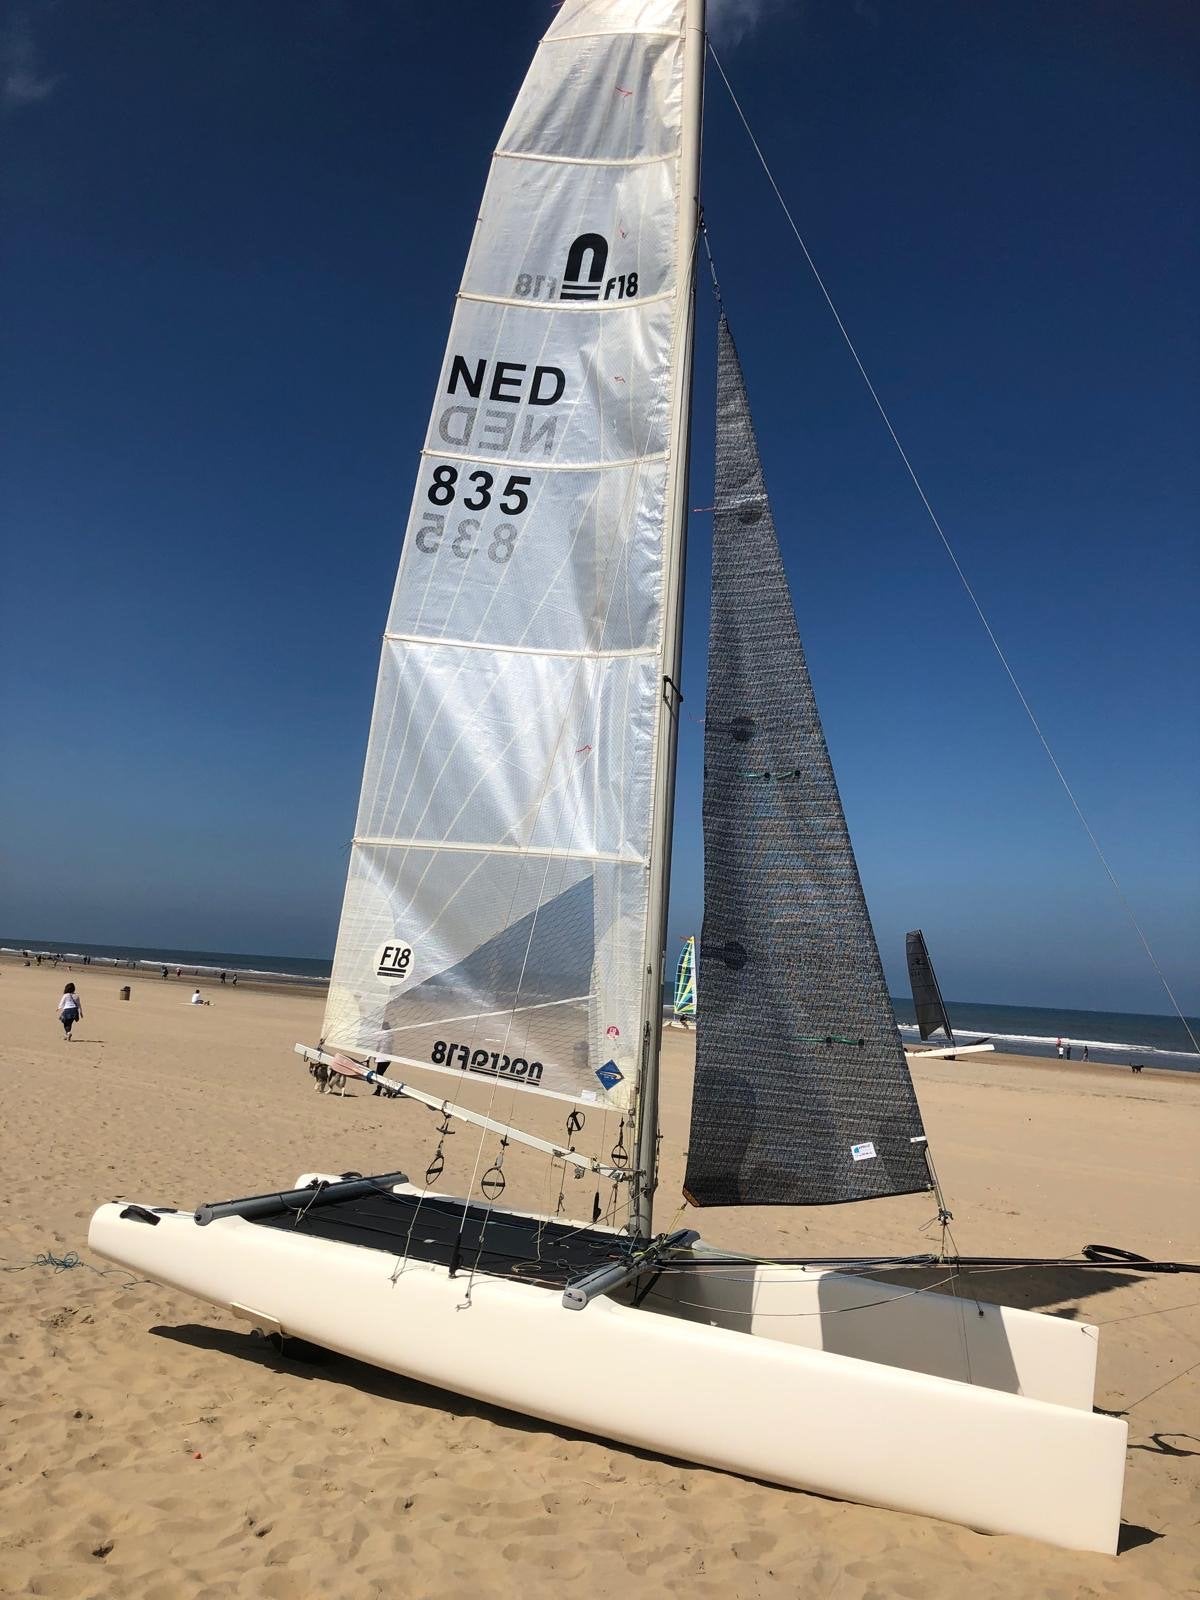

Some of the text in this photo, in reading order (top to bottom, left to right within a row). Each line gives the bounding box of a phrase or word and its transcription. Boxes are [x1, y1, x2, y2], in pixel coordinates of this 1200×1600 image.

[447, 355, 566, 406] NED
[428, 465, 531, 515] 835
[380, 946, 411, 968] F18
